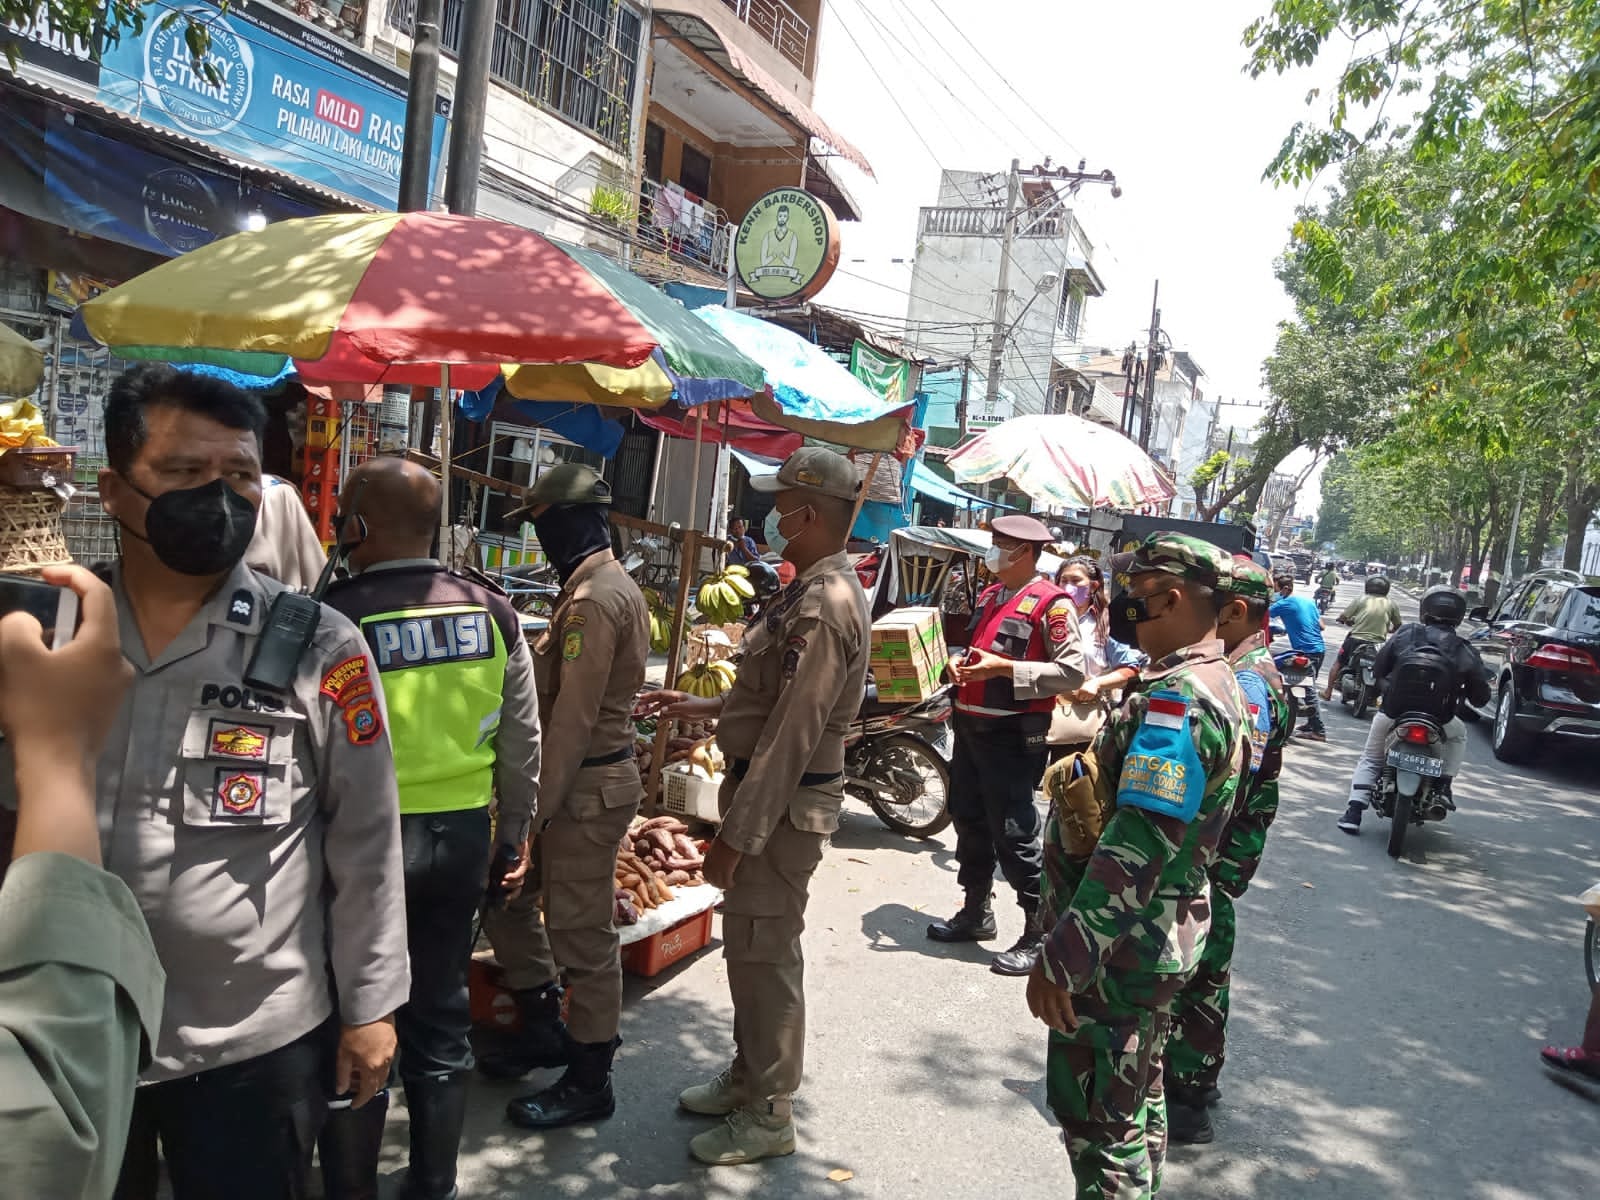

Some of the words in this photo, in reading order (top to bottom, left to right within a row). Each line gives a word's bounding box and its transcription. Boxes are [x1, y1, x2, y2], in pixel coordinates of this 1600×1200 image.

[301, 31, 345, 58] PERINGATAN:
[271, 73, 311, 110] RASA
[318, 95, 360, 130] MILD
[367, 113, 404, 153] RAS
[276, 108, 332, 148] PILIHAN
[333, 130, 362, 160] LAKI
[738, 206, 763, 245] KENN
[763, 193, 825, 246] BARBERSHOP
[374, 613, 490, 666] POLISI
